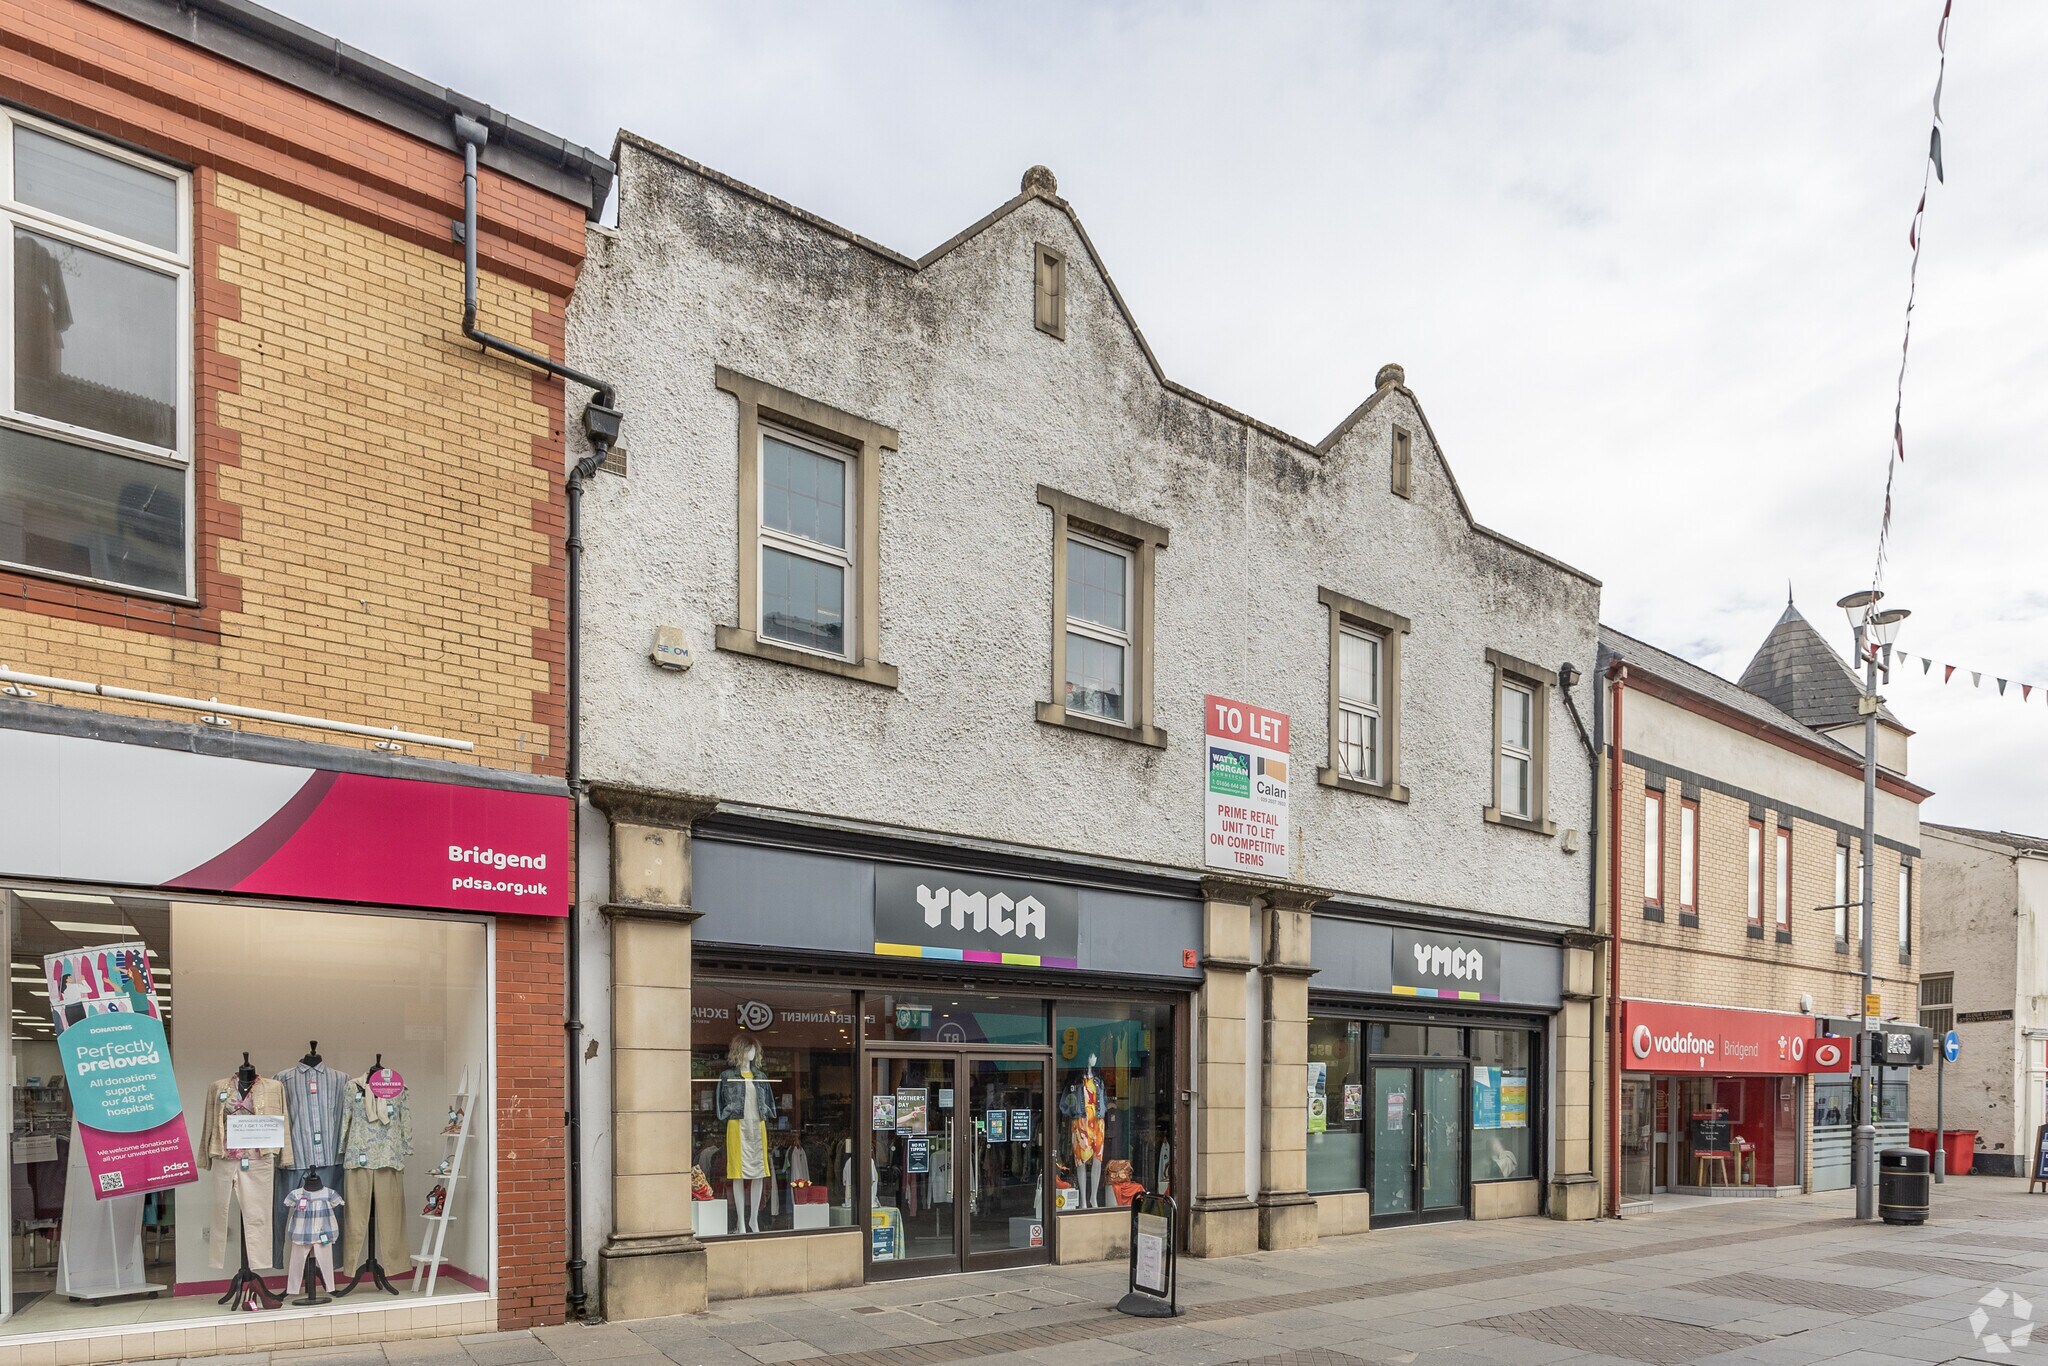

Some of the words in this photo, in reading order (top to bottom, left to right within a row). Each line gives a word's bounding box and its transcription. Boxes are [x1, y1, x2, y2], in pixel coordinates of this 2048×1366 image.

[658, 645, 688, 657] SEOM
[1216, 704, 1242, 733] TO
[1250, 713, 1281, 743] LET
[1212, 754, 1237, 764] WATTS
[1239, 755, 1247, 768] &
[1212, 771, 1247, 781] COMMERCIAL
[1213, 763, 1248, 775] MORGAN
[1257, 781, 1286, 799] Calan
[1218, 805, 1247, 820] PRIME
[1251, 810, 1278, 826] RETAIL
[1222, 820, 1242, 834] UNIT
[1246, 824, 1258, 836] TO
[1261, 827, 1275, 840] LET
[1211, 833, 1224, 846] ON
[1227, 836, 1285, 856] COMPETITIVE
[448, 846, 546, 870] Bridgend
[1234, 852, 1264, 866] TERMS
[452, 877, 547, 895] pdsa.org.uk
[917, 884, 1045, 940] YMCA
[1414, 943, 1483, 981] YMCA
[90, 1025, 132, 1034] DONATIONS
[76, 1040, 154, 1059] Perfectly
[1654, 1031, 1714, 1054] vodafone
[1724, 1040, 1758, 1060] Bridgend
[78, 1051, 160, 1076] preloved
[90, 1076, 103, 1088] All
[105, 1074, 157, 1086] donations
[105, 1084, 146, 1096] support
[102, 1098, 120, 1107] our
[122, 1095, 135, 1104] 48
[137, 1093, 154, 1104] pet
[107, 1104, 154, 1116] hospitals
[109, 1145, 139, 1154] welcome
[140, 1139, 172, 1149] donations
[128, 1148, 160, 1157] unwanted
[163, 1162, 189, 1173] pdsa
[147, 1171, 190, 1181] www.pdsa.org.uk
